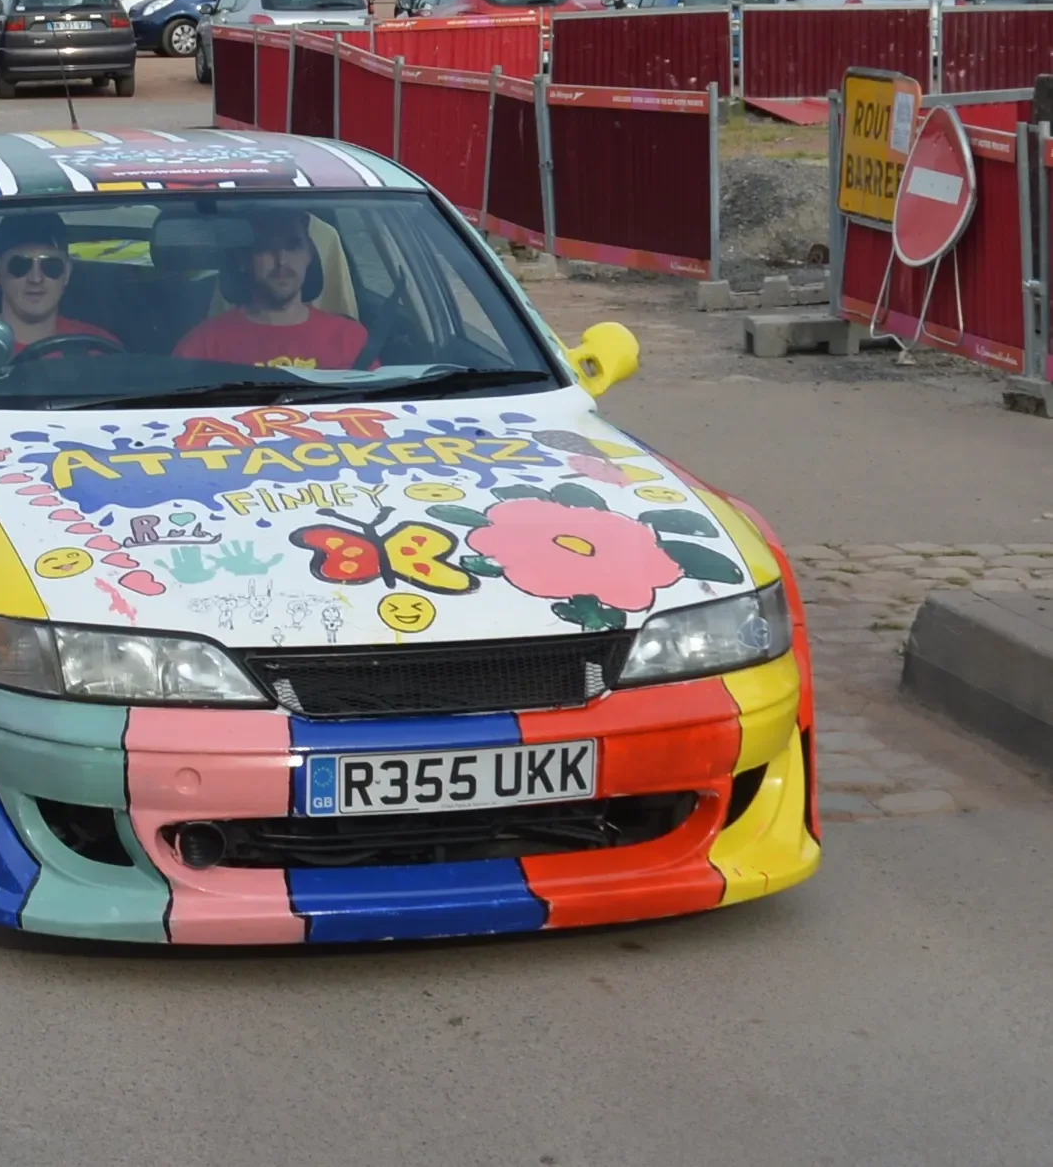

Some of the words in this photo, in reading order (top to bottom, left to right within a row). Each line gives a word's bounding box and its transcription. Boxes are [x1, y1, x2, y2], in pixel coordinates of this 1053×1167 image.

[853, 100, 892, 142] ROUT
[172, 406, 401, 449] ART
[52, 437, 548, 490] ATTACKERZ
[224, 481, 391, 516] FINLEY
[344, 755, 477, 808] R355
[494, 746, 589, 798] UKK
[313, 797, 334, 809] GB
